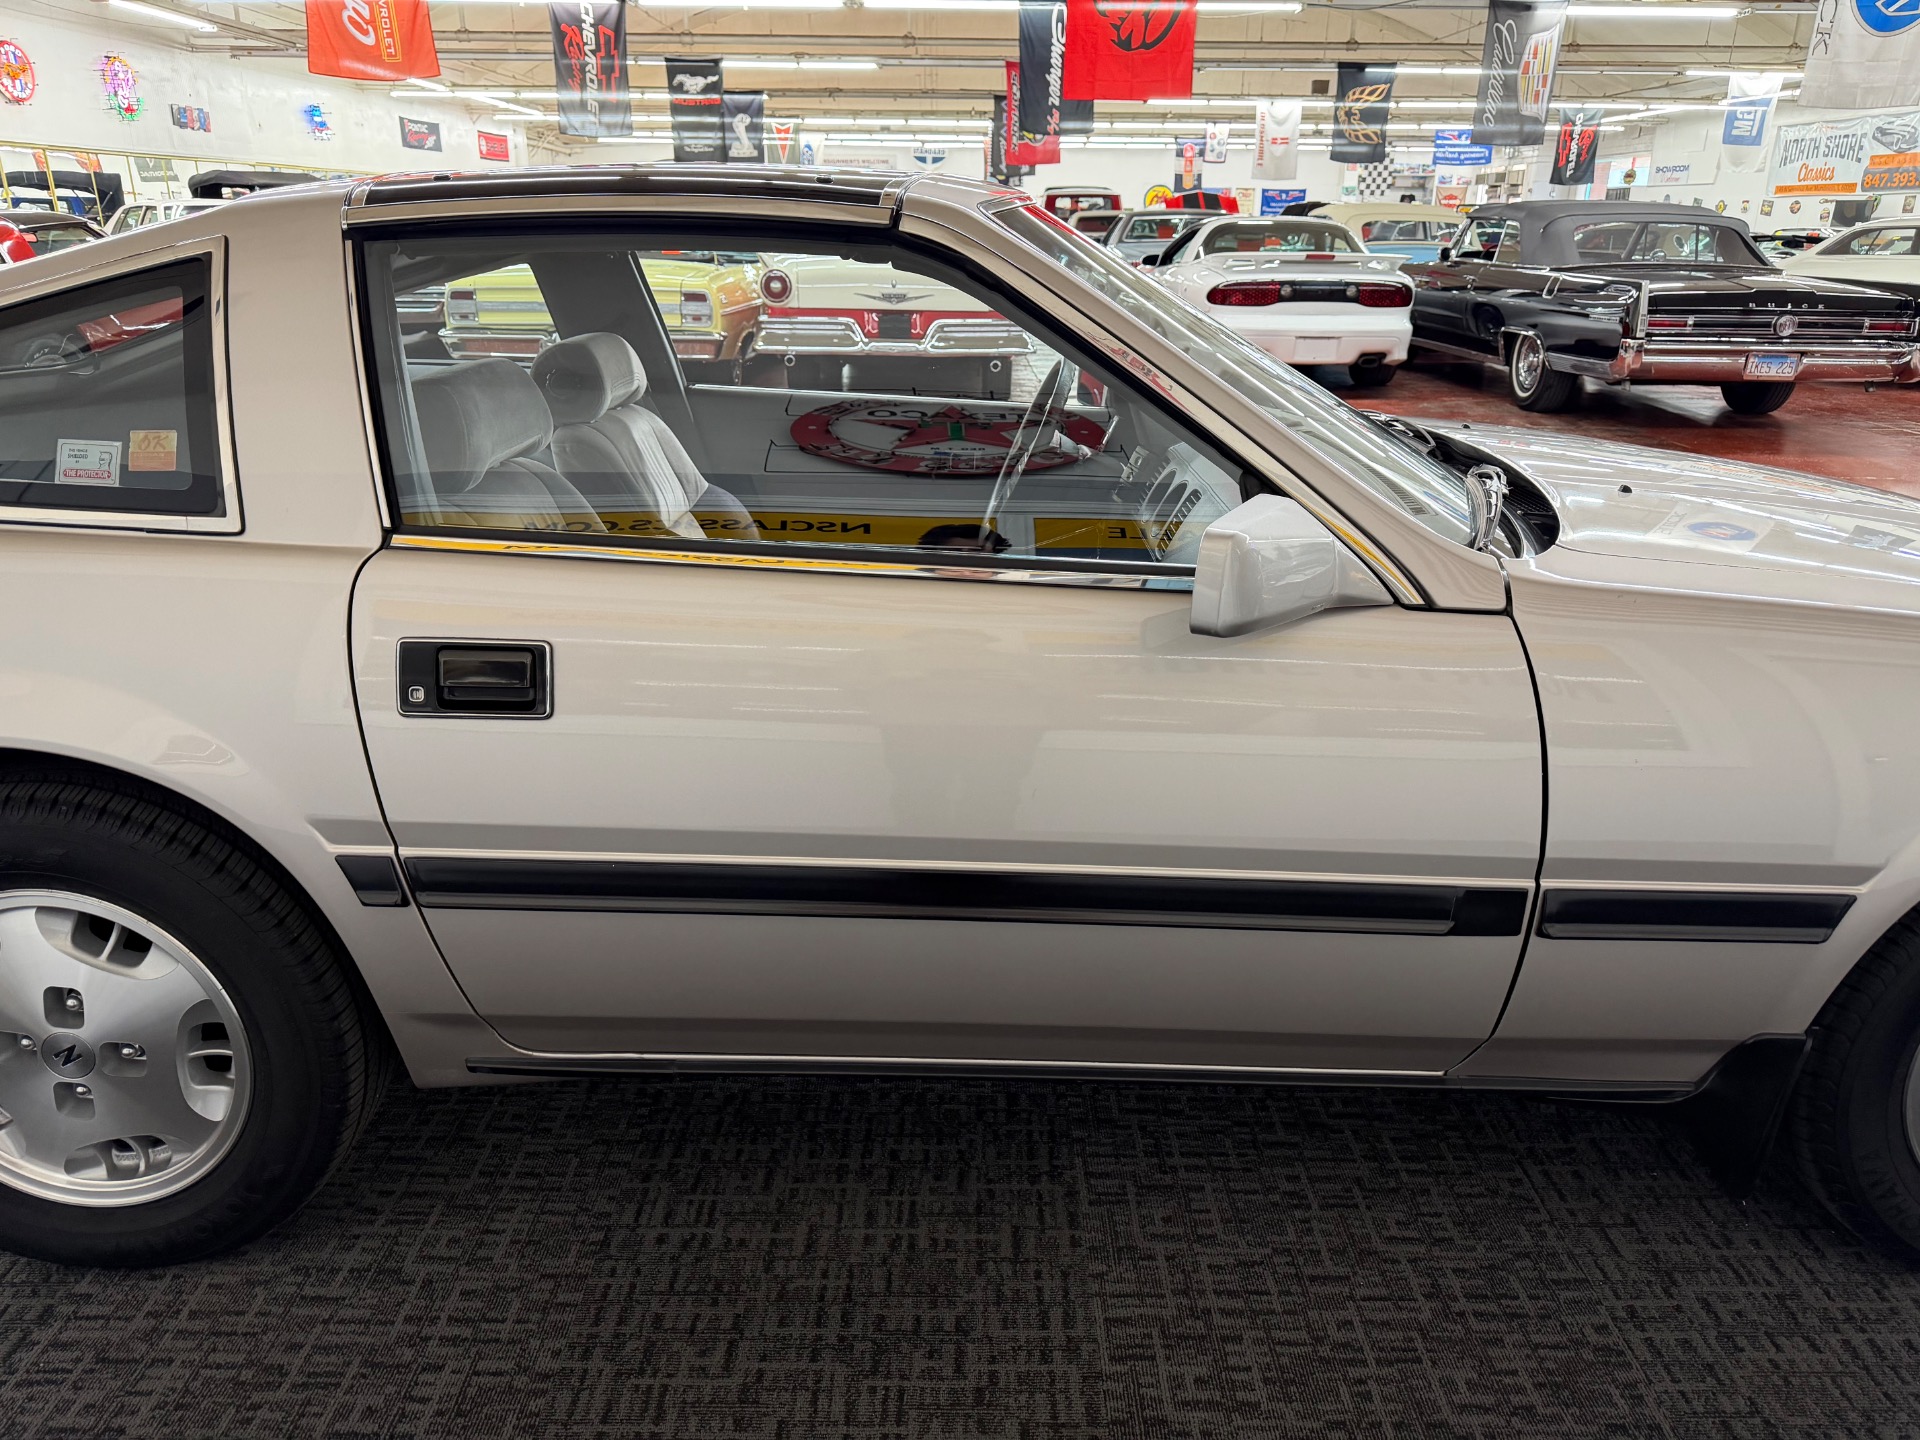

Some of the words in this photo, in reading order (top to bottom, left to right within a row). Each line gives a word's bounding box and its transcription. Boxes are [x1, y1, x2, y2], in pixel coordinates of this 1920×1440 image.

[580, 1, 600, 129] CHEVROLET
[1046, 2, 1068, 107] Charger
[1482, 19, 1518, 128] Cadillac
[673, 98, 721, 106] MUSTANG
[1778, 135, 1821, 168] NORTH
[1822, 133, 1868, 164] SHORE
[1797, 161, 1836, 183] Classics
[1749, 302, 1825, 310] BUICK
[1775, 361, 1795, 375] 225
[66, 469, 77, 478] THE
[77, 469, 108, 480] PROTECTOR
